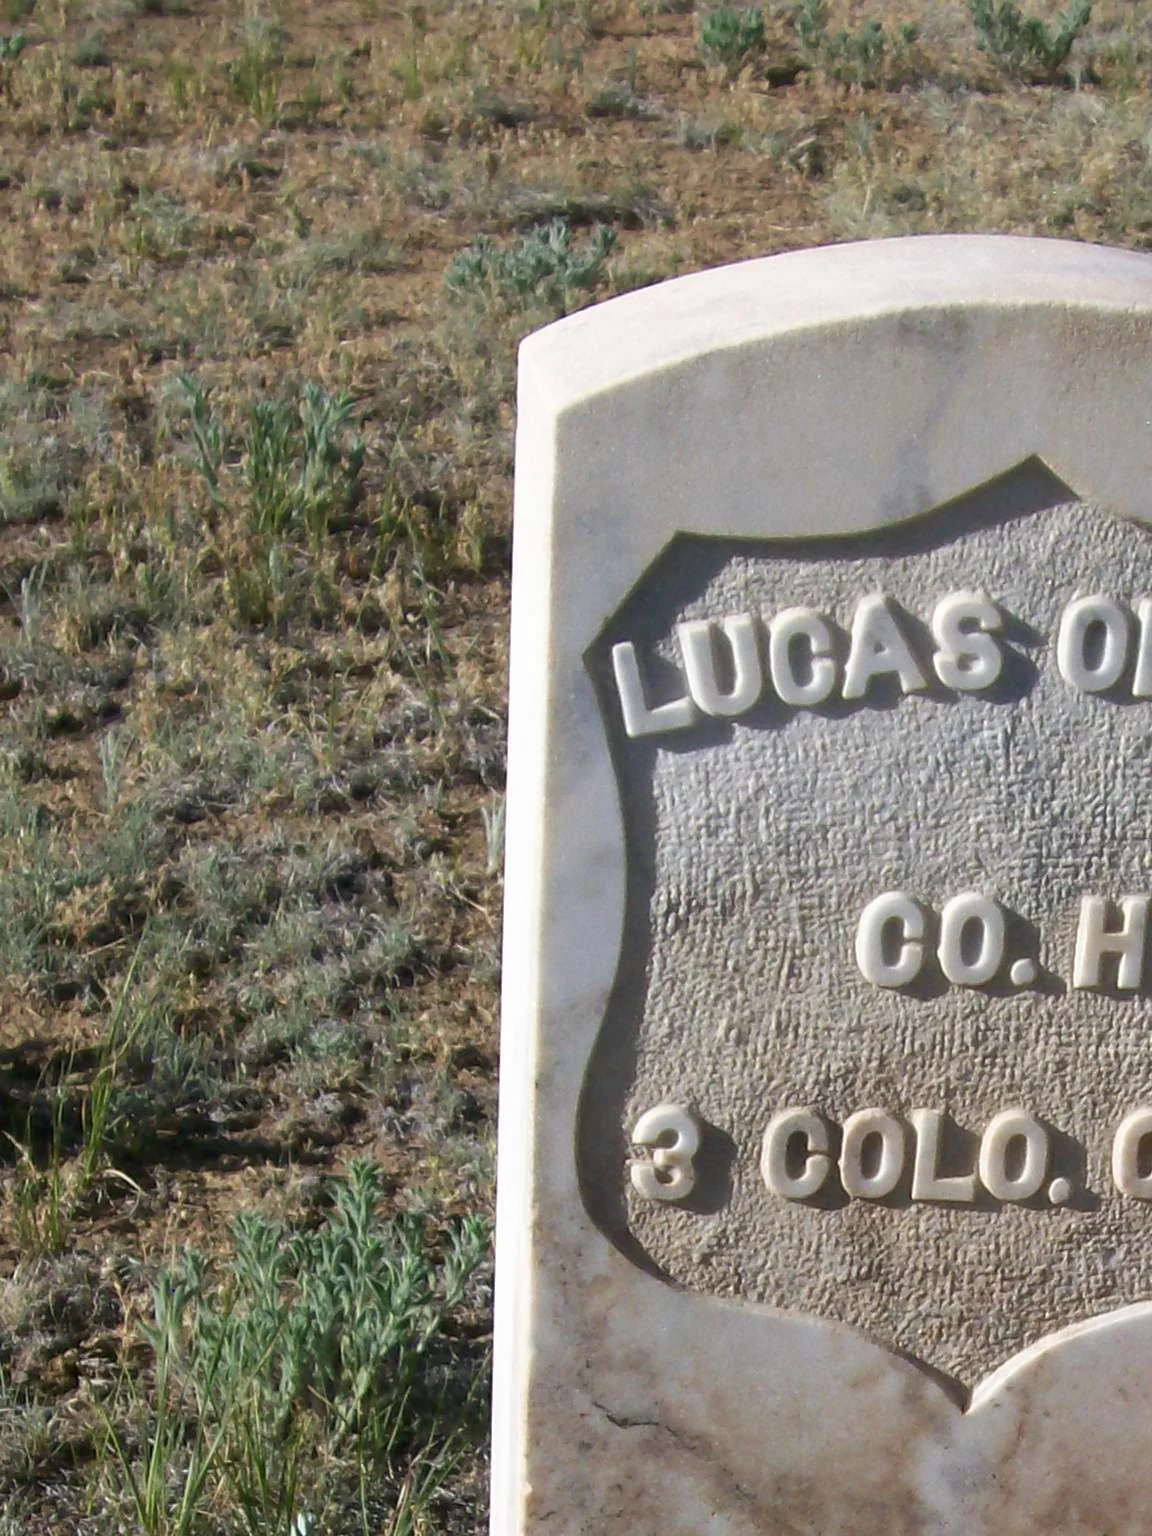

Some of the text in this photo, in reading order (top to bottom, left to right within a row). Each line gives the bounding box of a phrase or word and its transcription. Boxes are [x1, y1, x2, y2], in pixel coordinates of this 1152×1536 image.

[613, 591, 1003, 738] LUCAS
[855, 891, 1148, 989] CO. H
[629, 1104, 702, 1201] 3
[762, 1106, 1070, 1203] COLO.
